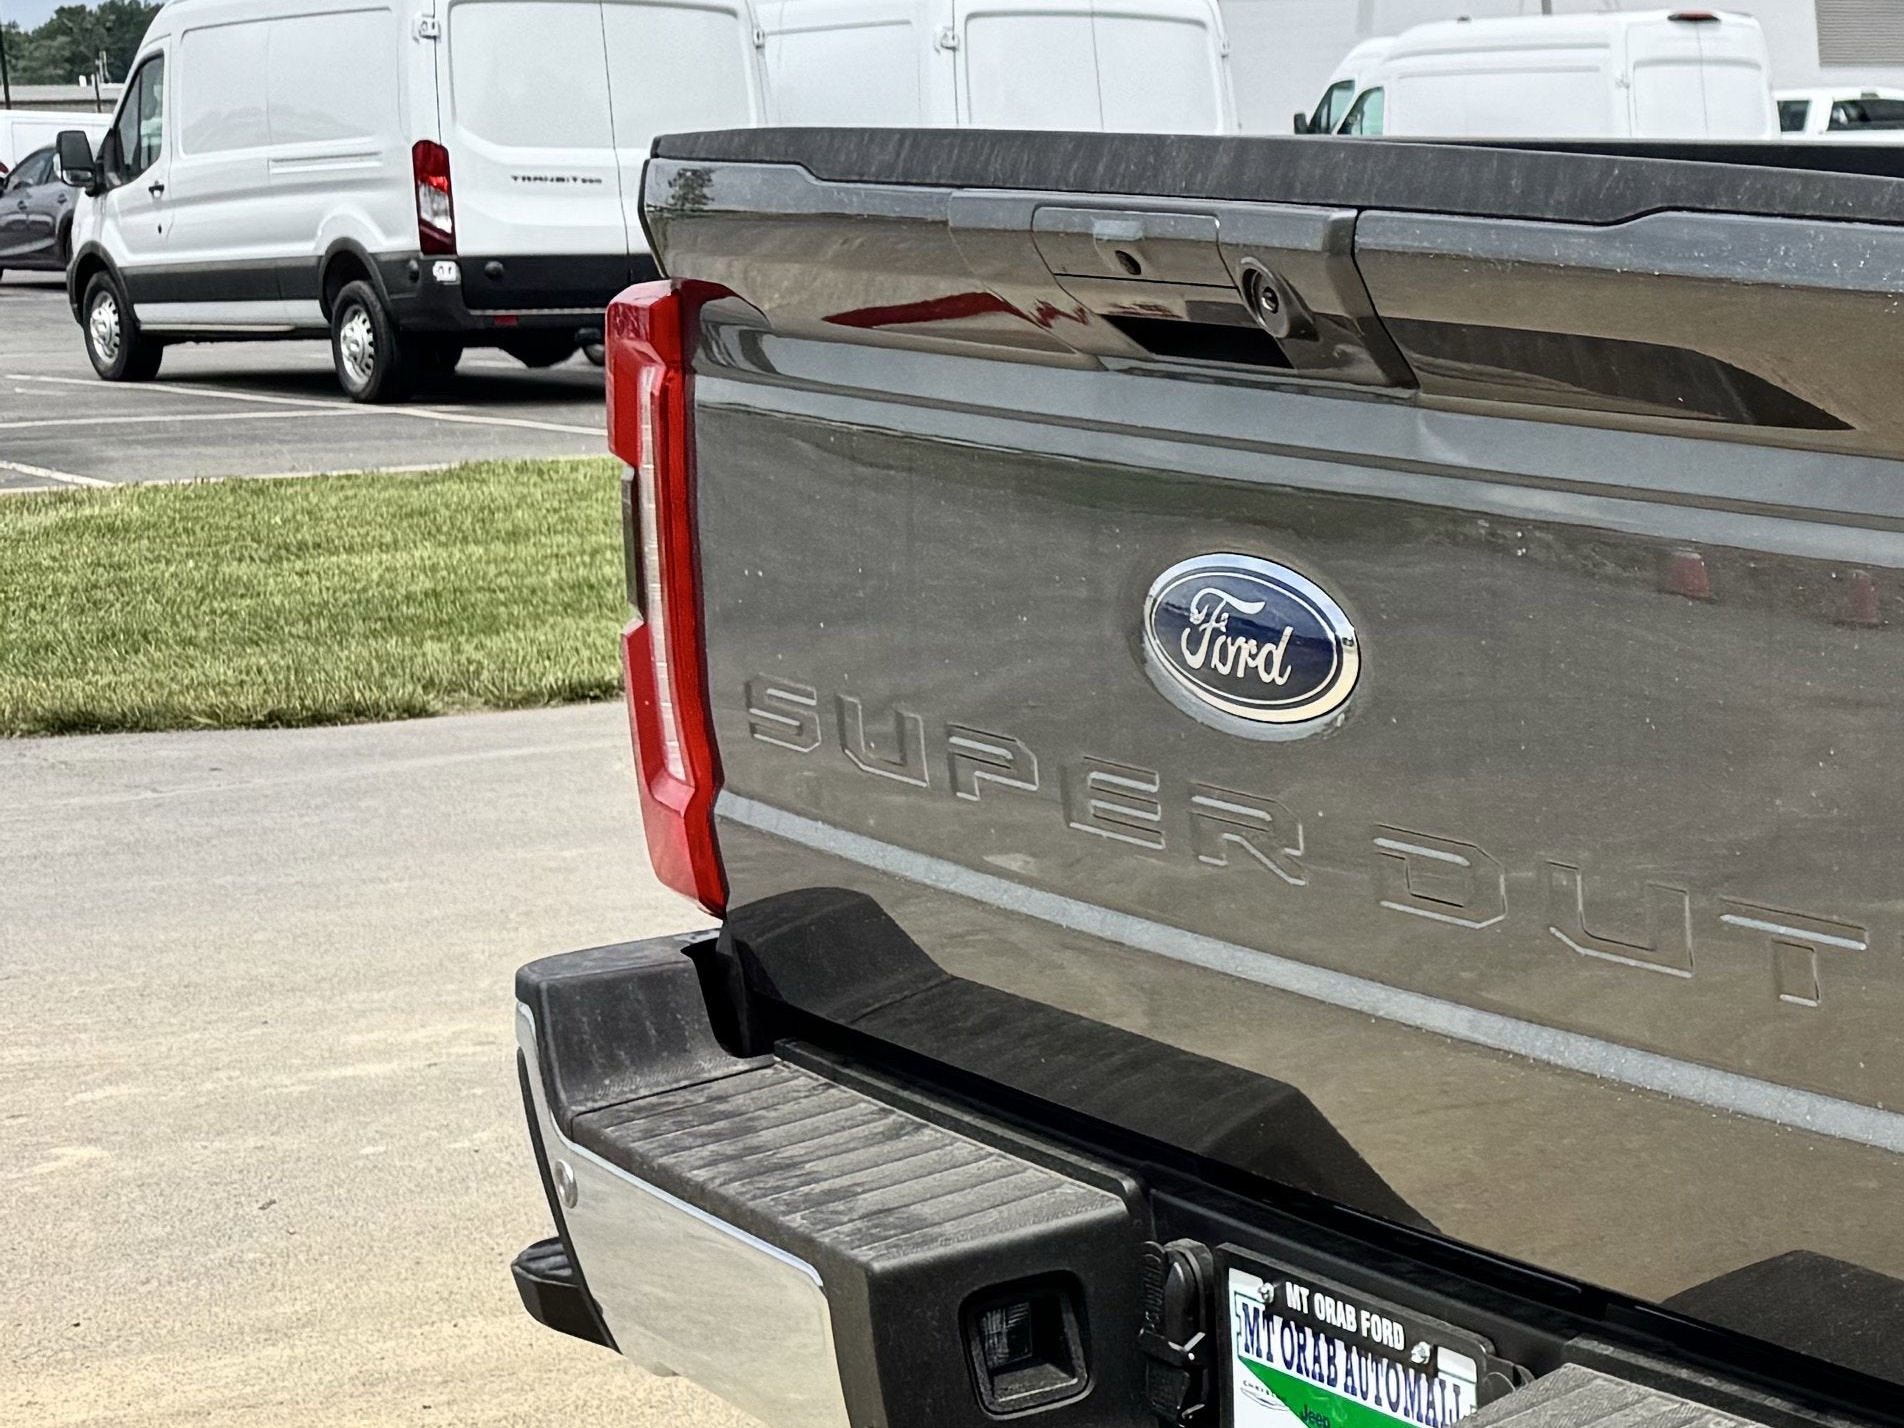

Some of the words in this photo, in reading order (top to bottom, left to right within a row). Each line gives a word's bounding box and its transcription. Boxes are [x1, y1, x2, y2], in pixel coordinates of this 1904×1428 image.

[1181, 587, 1294, 686] Ford
[745, 672, 1308, 888] SUPER
[1242, 1302, 1278, 1364] MT
[1279, 1318, 1339, 1388] ORAB
[1285, 1280, 1310, 1315] MT
[1314, 1292, 1358, 1334] ORAB
[1360, 1309, 1406, 1351] FORD
